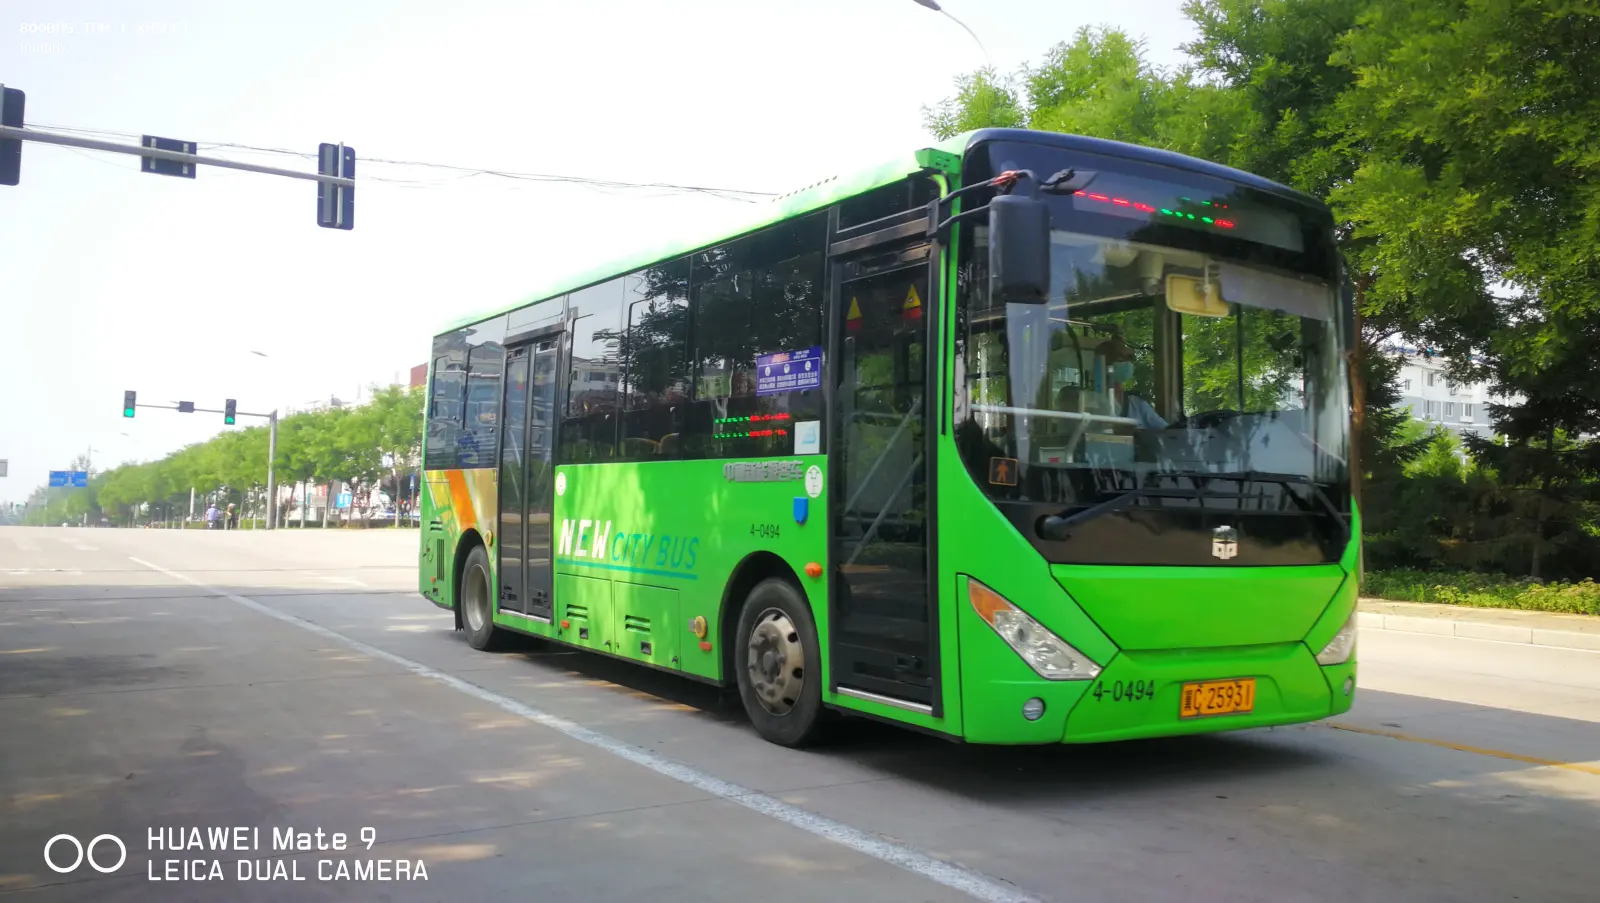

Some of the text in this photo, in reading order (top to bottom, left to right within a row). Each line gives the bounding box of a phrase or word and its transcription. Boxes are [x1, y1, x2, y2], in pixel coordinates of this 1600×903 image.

[749, 523, 781, 539] 4-0494
[558, 518, 700, 570] NEW CITY BUS
[1092, 679, 1155, 702] 4-0494
